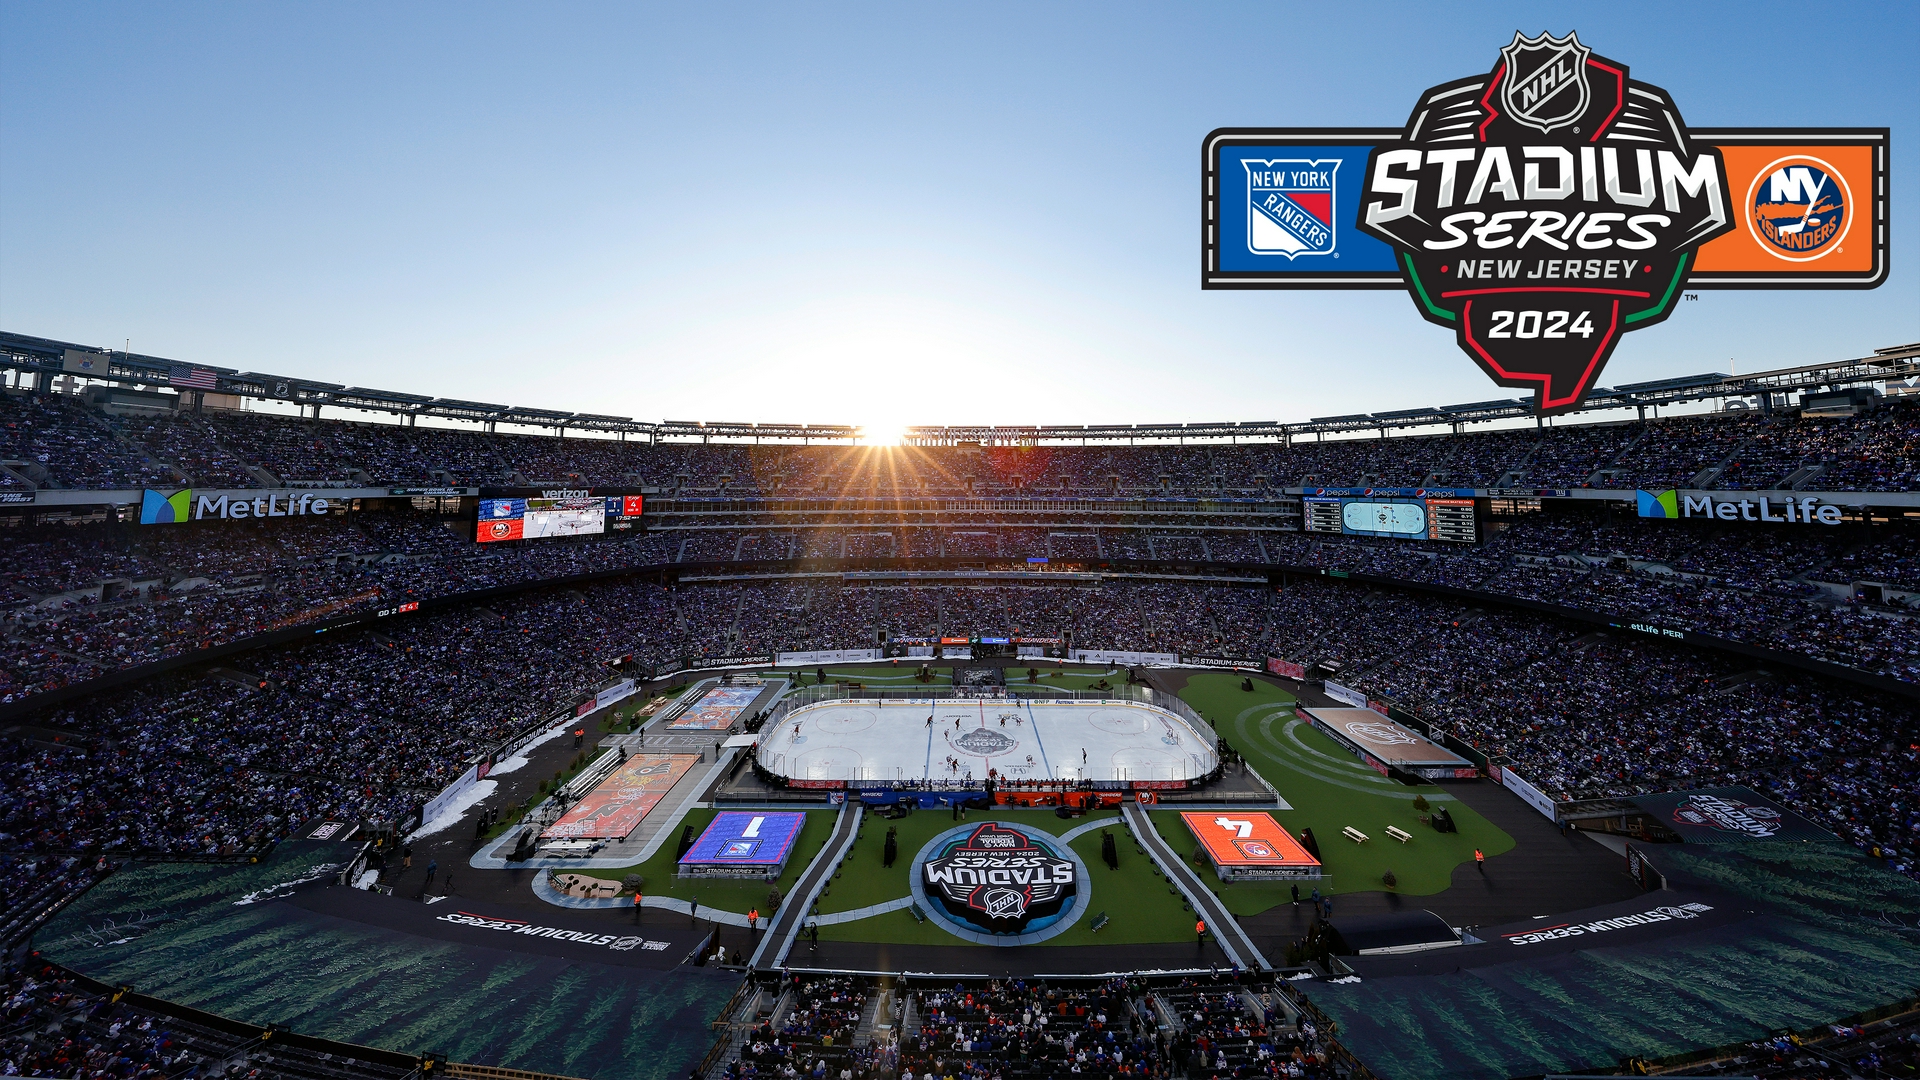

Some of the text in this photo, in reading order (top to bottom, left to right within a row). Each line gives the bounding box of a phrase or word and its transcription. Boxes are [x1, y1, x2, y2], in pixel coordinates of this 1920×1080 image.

[542, 488, 589, 498] verizon
[1326, 488, 1350, 497] pepsi
[1375, 488, 1400, 497] pepsi
[1427, 490, 1455, 498] pepsi
[195, 493, 329, 520] MetLife
[1683, 496, 1843, 525] MetLife
[711, 658, 743, 666] STADIUM
[1200, 658, 1232, 666] STADIUM
[513, 711, 571, 751] STADIUM SERIES
[1689, 794, 1775, 838] STADIUM
[741, 816, 766, 838] 1
[1213, 817, 1254, 838] 4
[948, 857, 1047, 868] SERIES
[926, 861, 1074, 885] STADIUM
[992, 893, 1015, 910] NHL
[436, 913, 524, 931] SERIES
[1509, 910, 1673, 946] STADIUM SERIES
[512, 924, 618, 946] STADIUM
